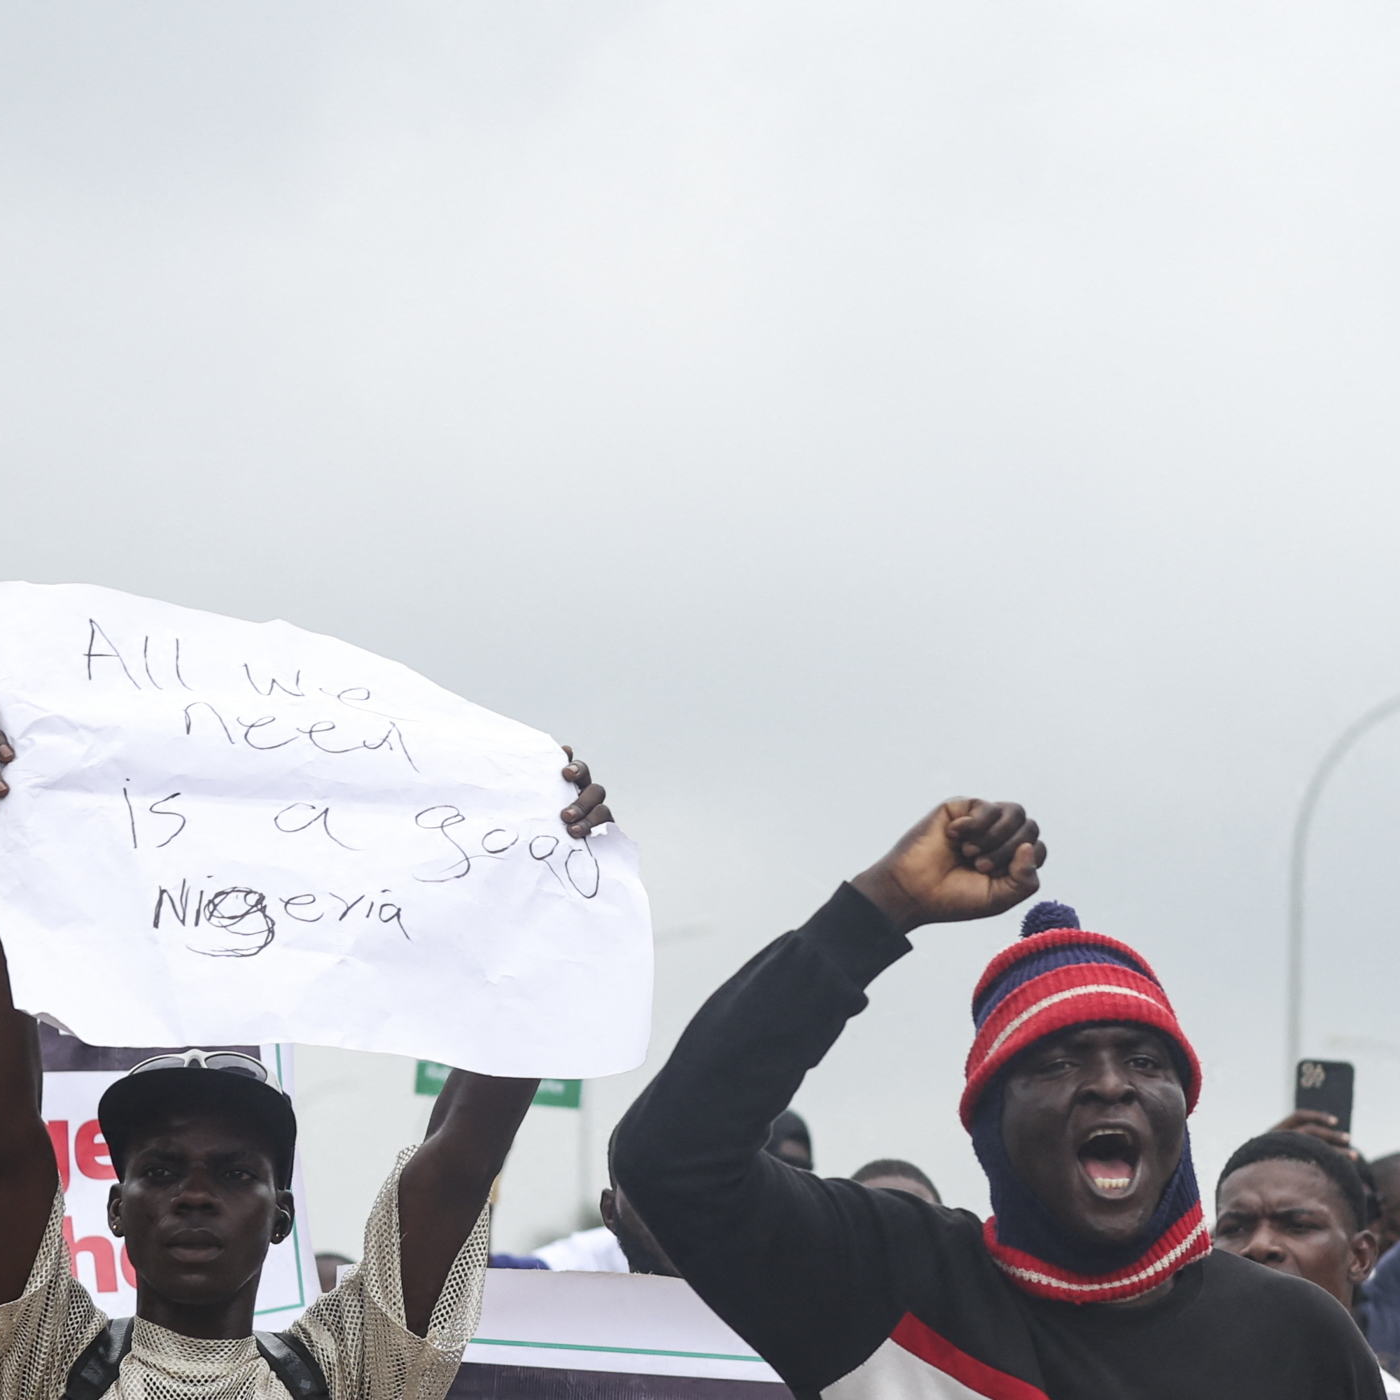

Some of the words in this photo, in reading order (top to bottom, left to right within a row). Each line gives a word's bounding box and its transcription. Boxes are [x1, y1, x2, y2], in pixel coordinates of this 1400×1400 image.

[83, 618, 193, 690] All
[183, 700, 420, 773] need
[123, 777, 186, 848] is
[274, 802, 366, 850] a
[153, 875, 412, 957] Nigeria
